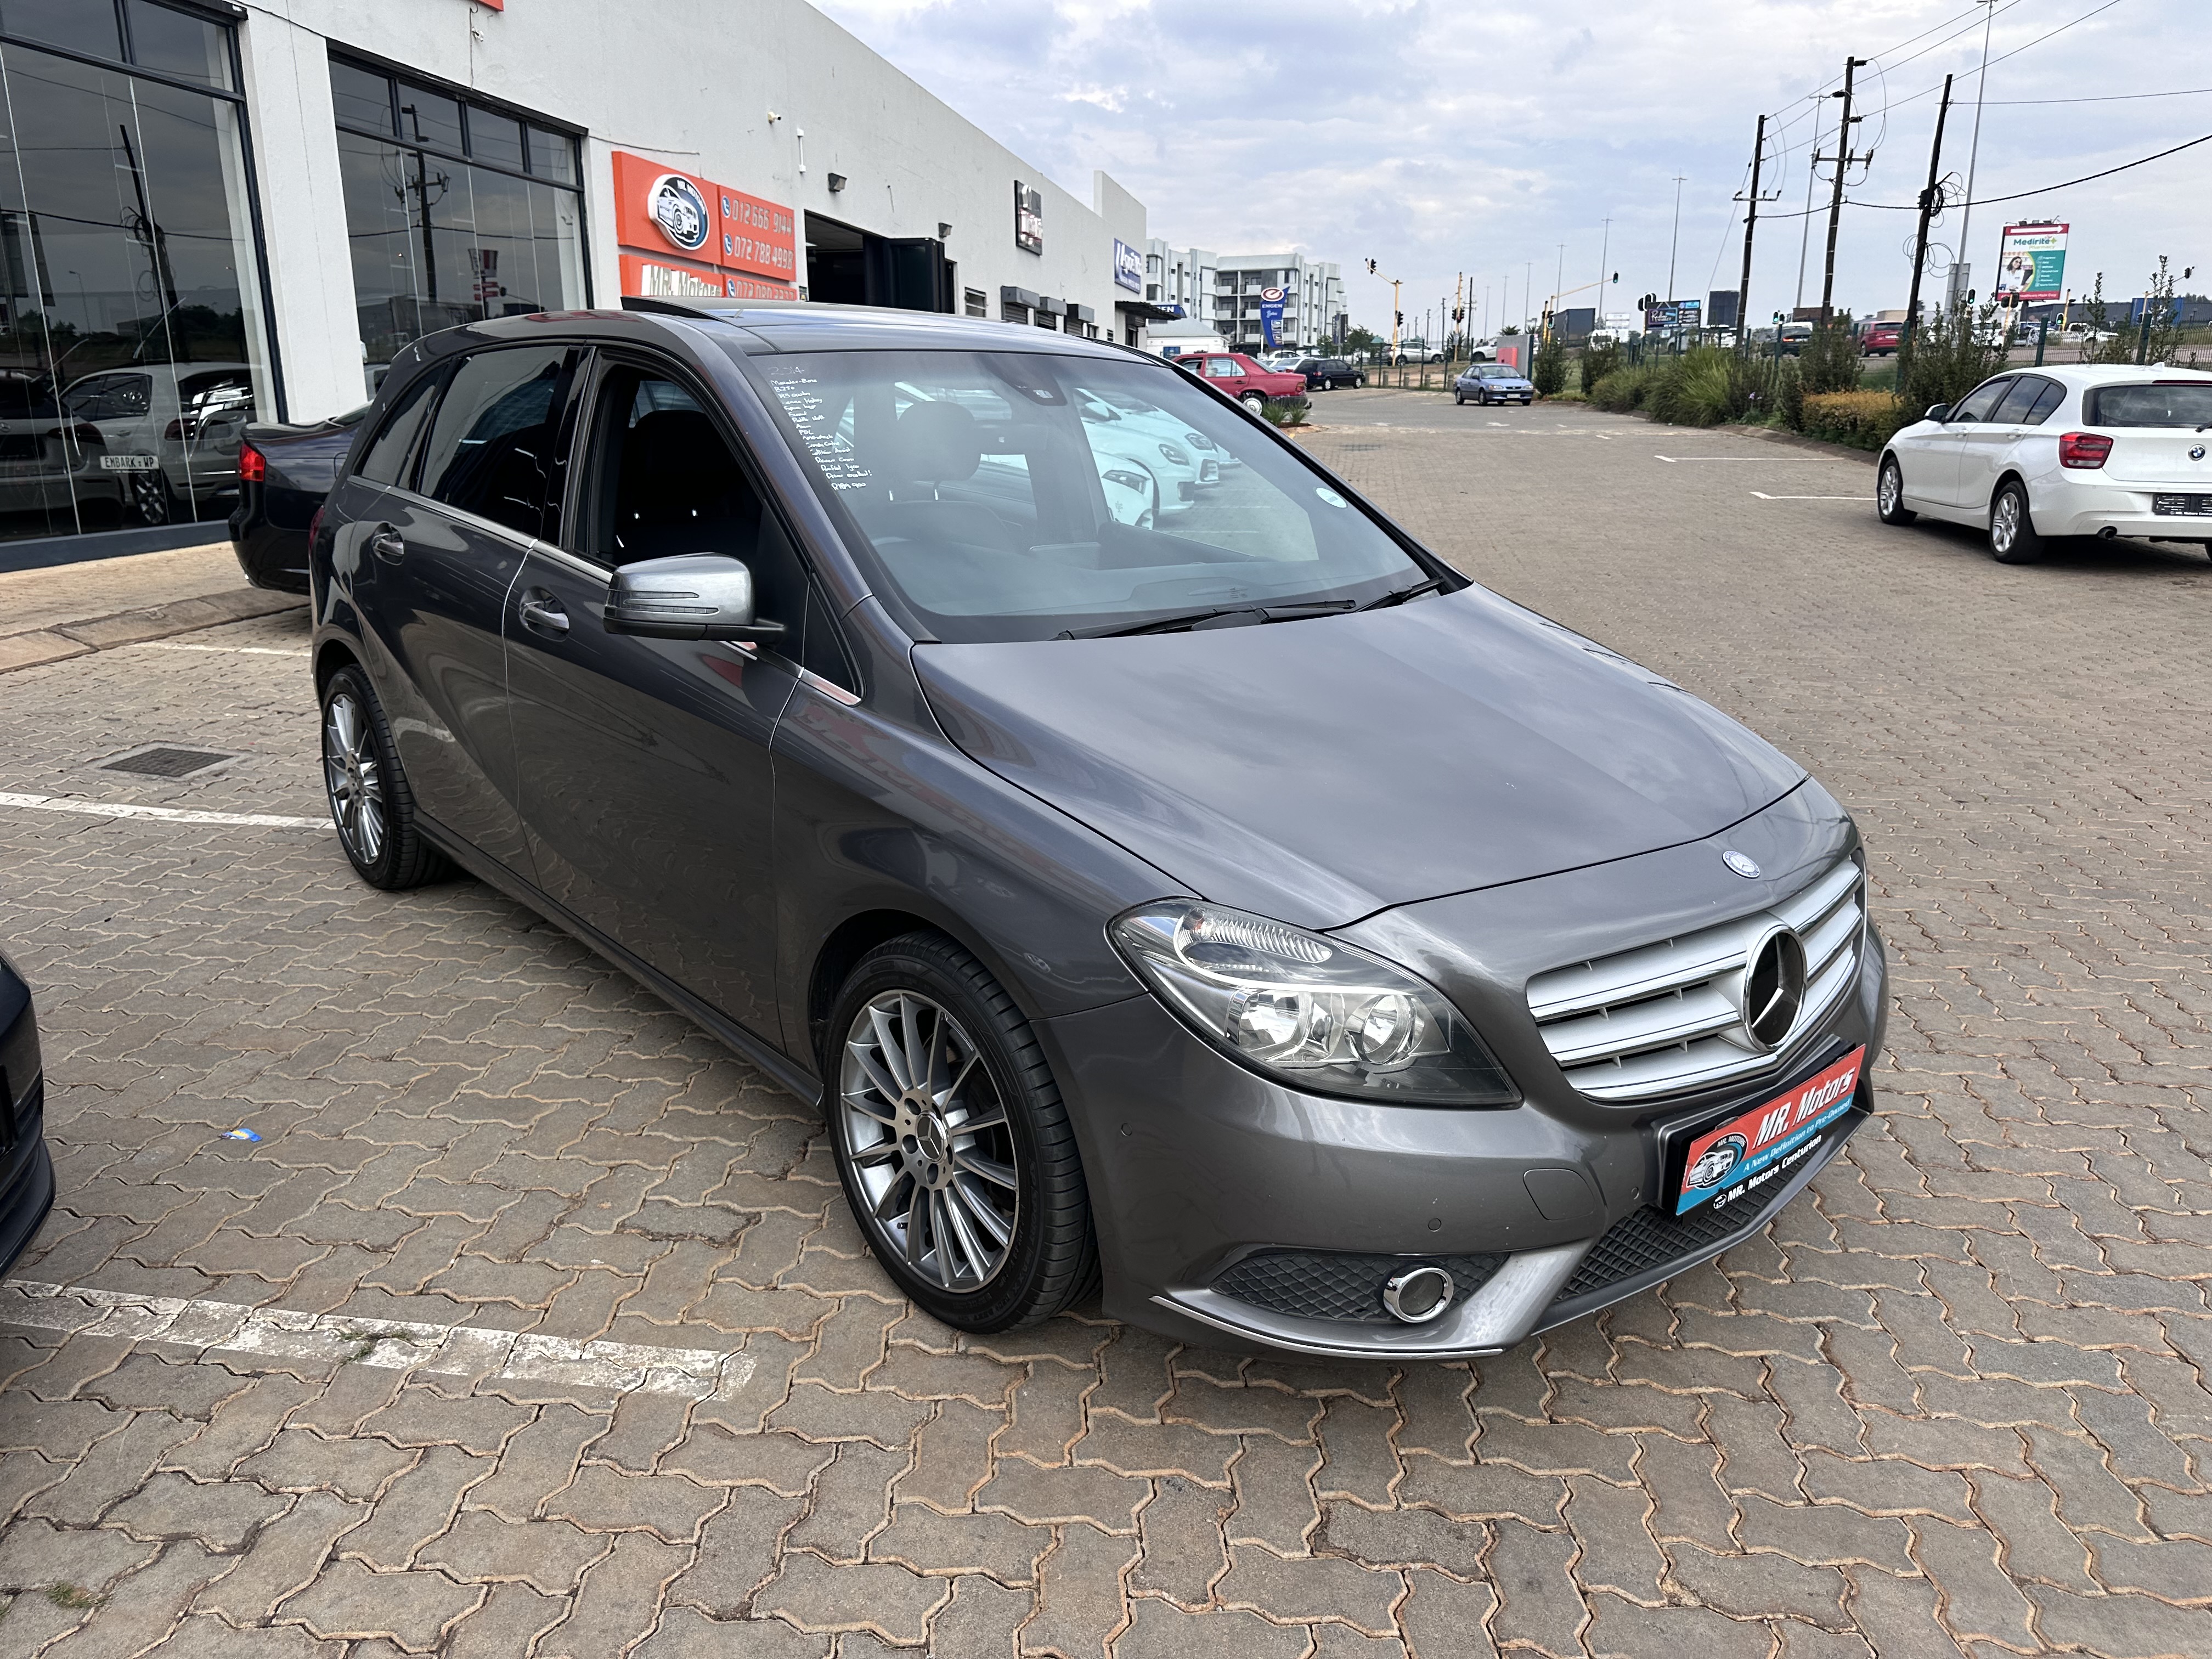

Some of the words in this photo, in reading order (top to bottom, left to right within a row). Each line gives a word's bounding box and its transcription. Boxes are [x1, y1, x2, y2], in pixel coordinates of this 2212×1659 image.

[732, 199, 751, 224] 012
[752, 205, 770, 230] 666
[772, 212, 793, 237] 9144
[735, 235, 753, 261] 072
[754, 240, 772, 265] 788
[772, 246, 794, 270] 4998
[105, 456, 136, 467] EMBARK
[143, 456, 154, 467] WP
[1752, 1102, 1792, 1150] MR.
[1792, 1066, 1856, 1127] Motors
[1728, 1135, 1746, 1148] MOTORS
[1743, 1163, 1750, 1172] A
[1751, 1154, 1768, 1168] New
[1770, 1130, 1805, 1158] Definition
[1806, 1124, 1814, 1134] to
[1815, 1098, 1851, 1128] Pre-Owned
[1728, 1184, 1746, 1202] MR.
[1747, 1164, 1780, 1190] Motors
[1781, 1135, 1822, 1169] Centurion
